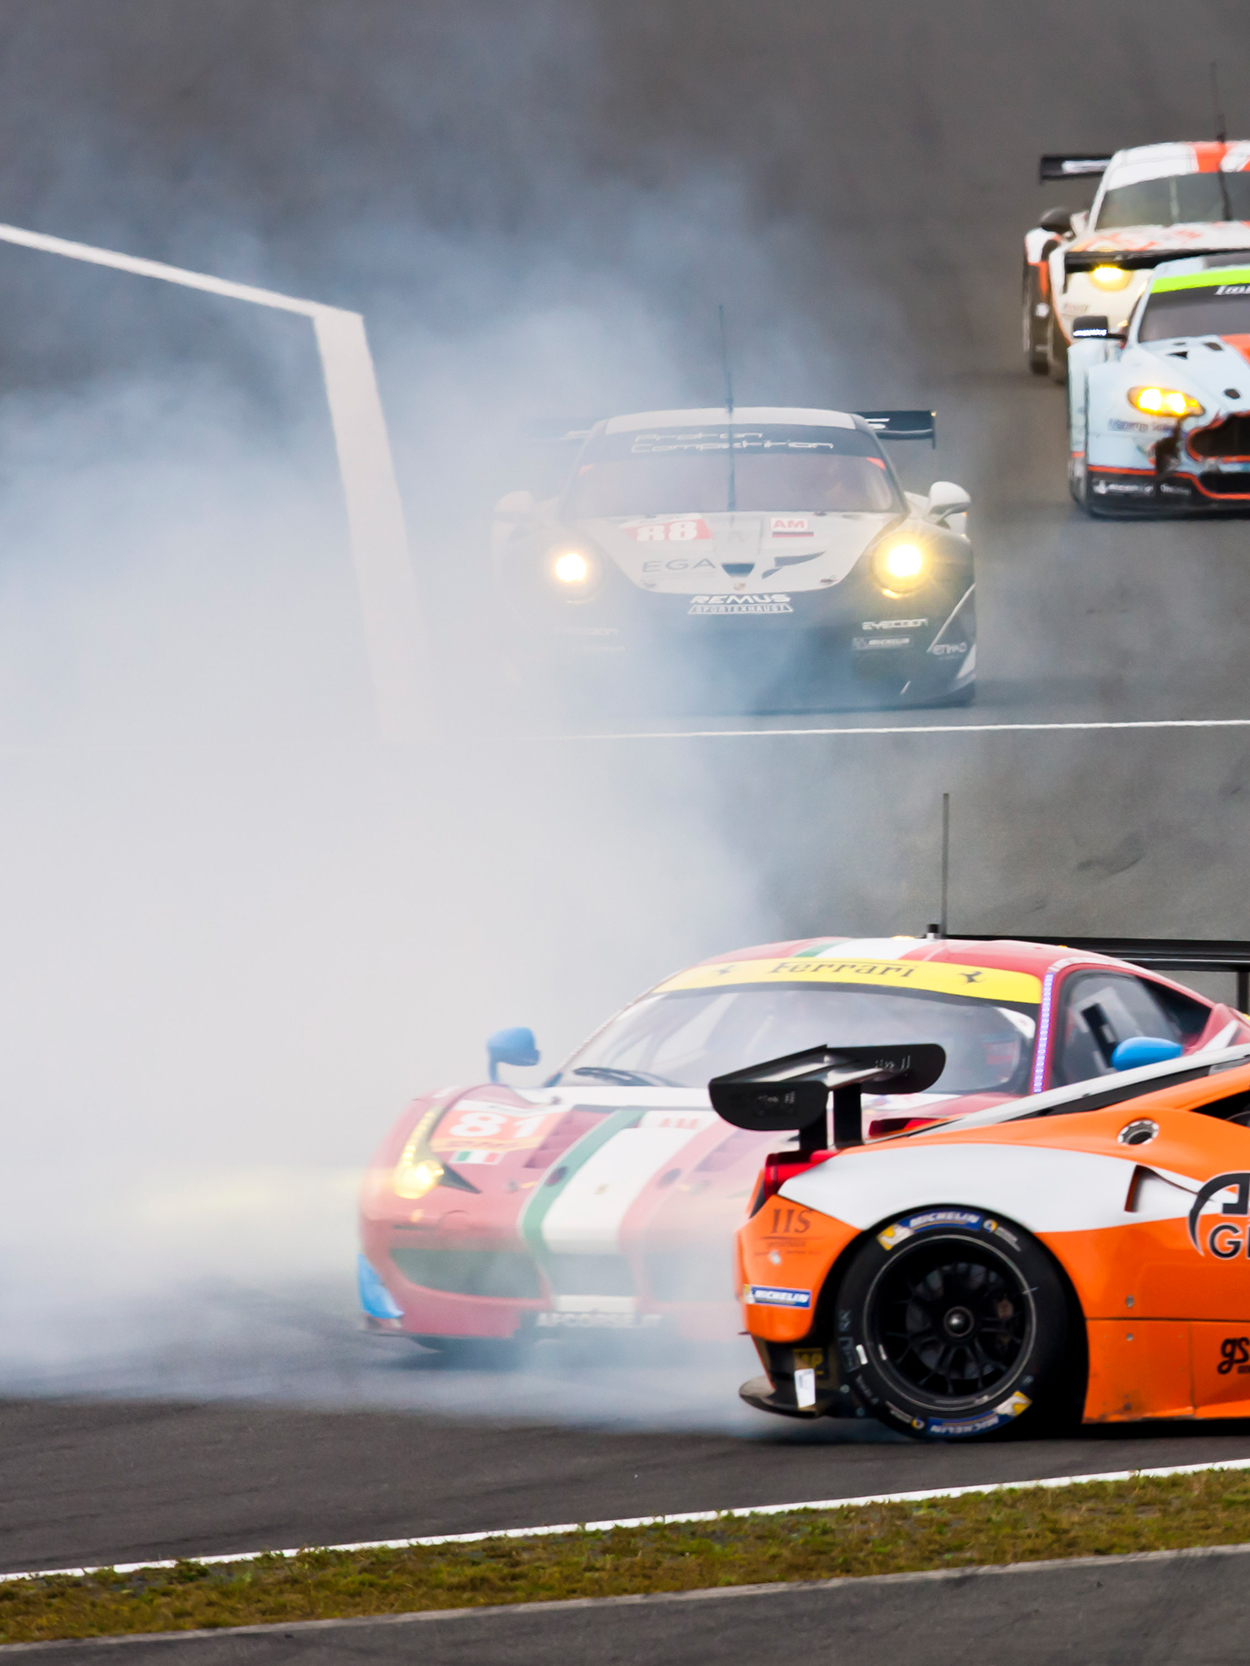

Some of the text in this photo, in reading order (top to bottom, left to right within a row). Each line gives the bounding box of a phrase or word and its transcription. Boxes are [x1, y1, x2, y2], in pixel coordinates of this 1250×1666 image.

[636, 520, 698, 542] 88
[772, 520, 807, 530] AM
[642, 558, 716, 573] EGA
[690, 593, 792, 604] REMUS
[768, 961, 920, 979] Ferrari
[449, 1112, 547, 1139] 81
[909, 1211, 981, 1228] MICHELIN
